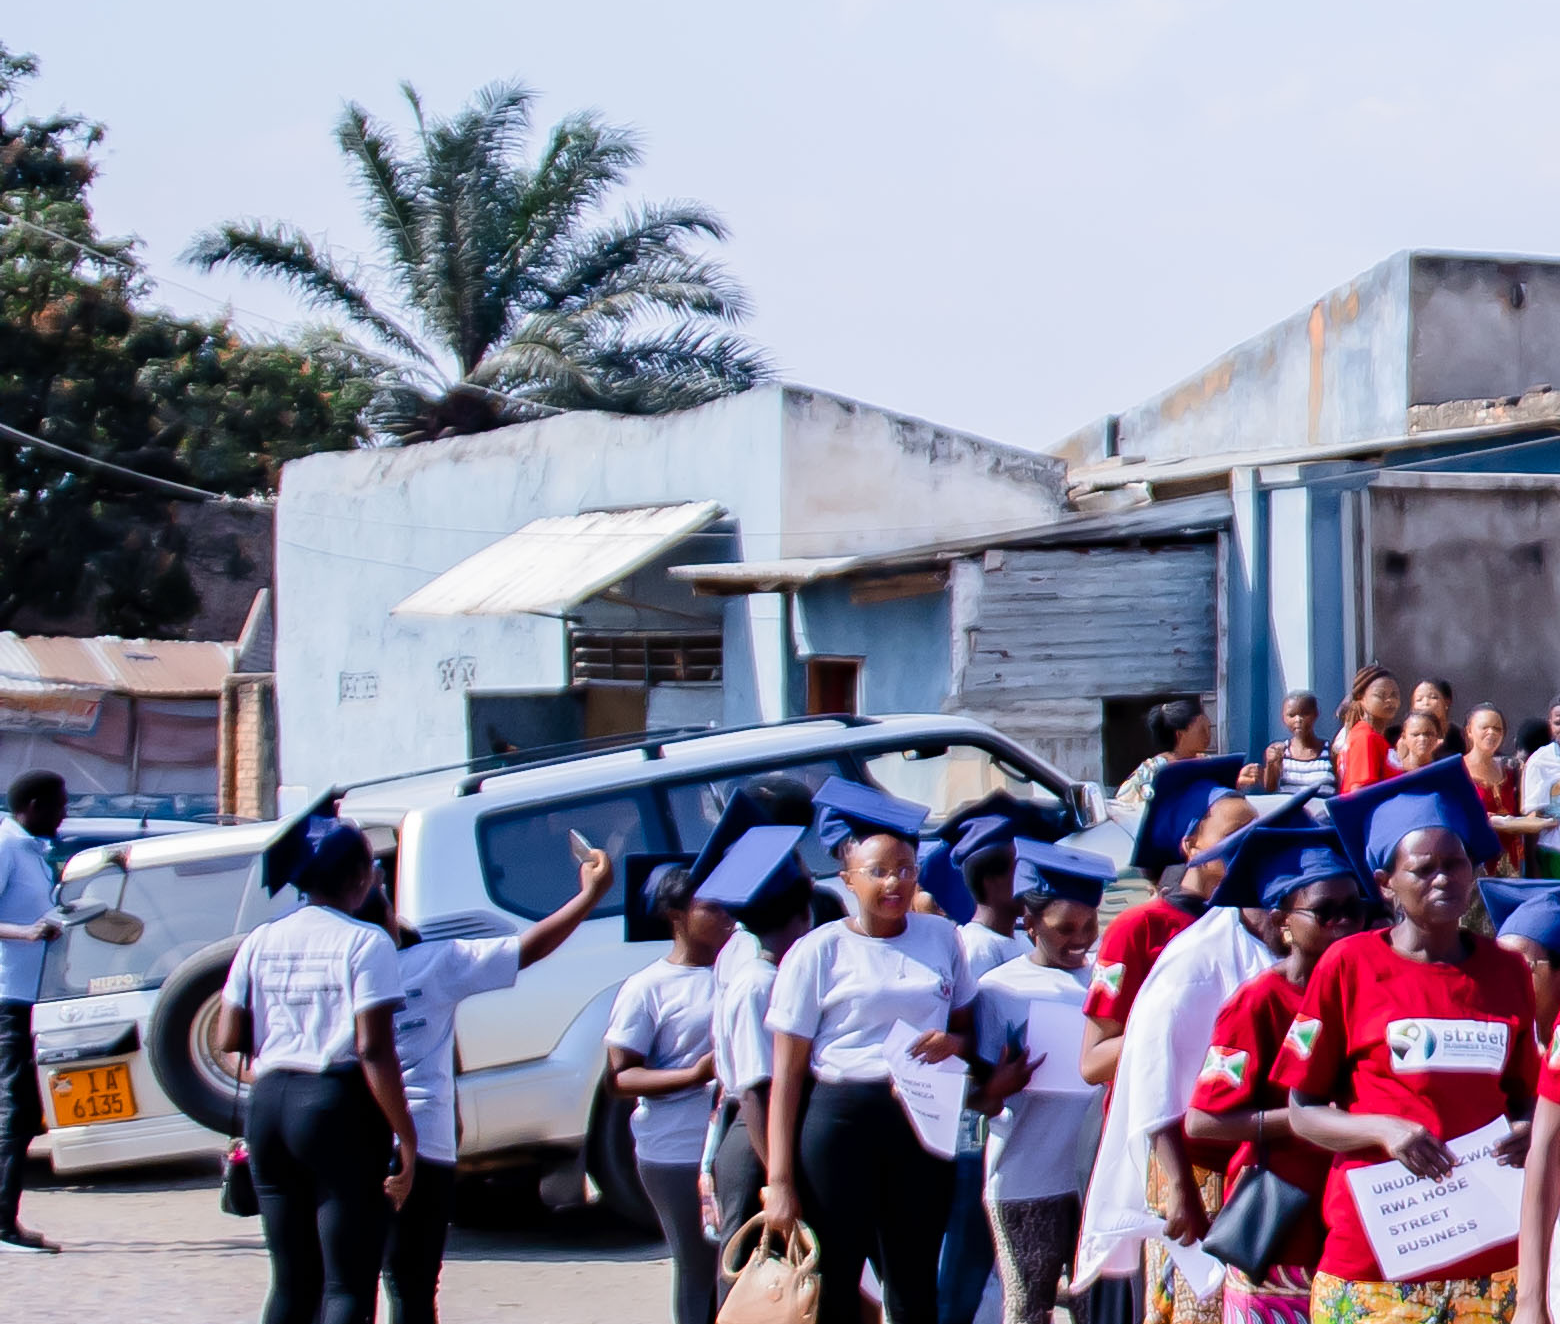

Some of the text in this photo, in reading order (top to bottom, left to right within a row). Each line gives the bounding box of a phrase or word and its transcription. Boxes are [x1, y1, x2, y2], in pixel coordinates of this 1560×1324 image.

[1443, 1027, 1504, 1047] street
[74, 1093, 123, 1118] 6135
[1380, 1177, 1469, 1216] RWA HOSE
[1388, 1207, 1450, 1236] STREET
[1397, 1219, 1478, 1255] BUSINESS
